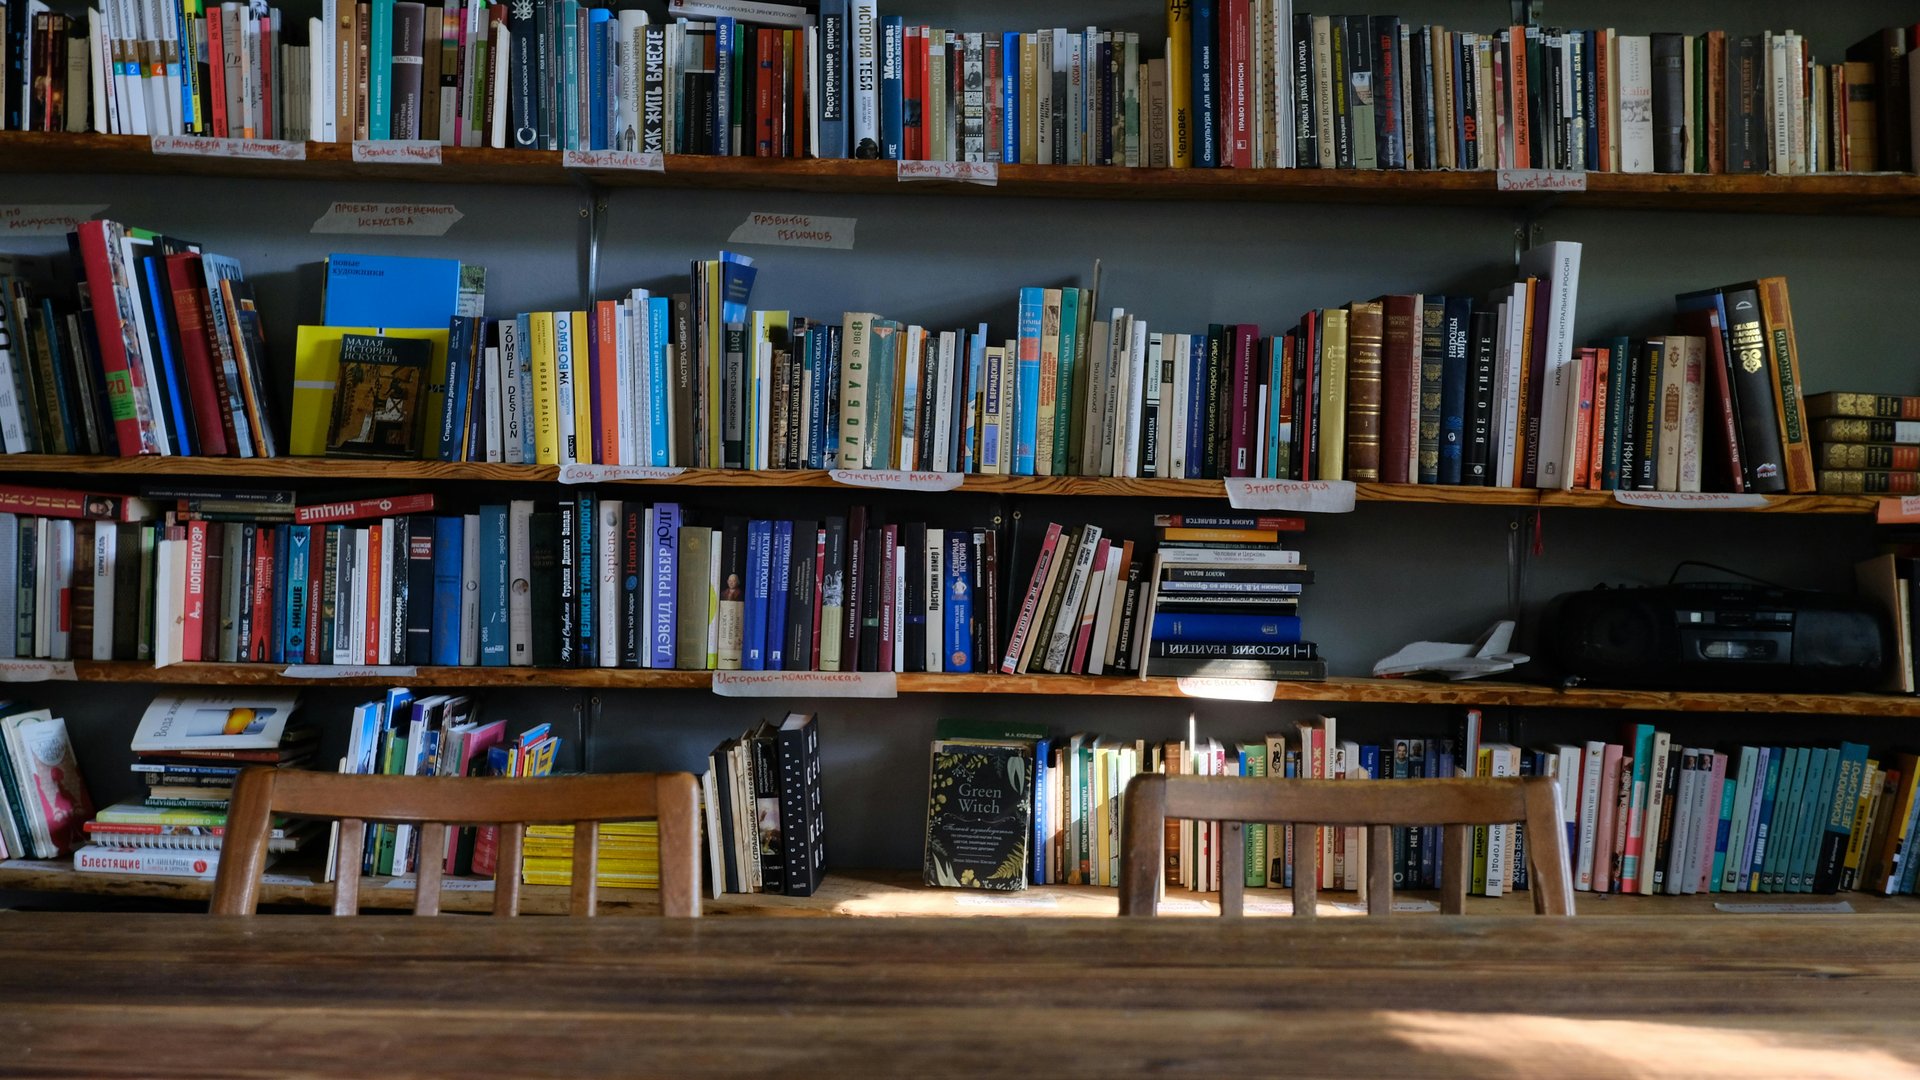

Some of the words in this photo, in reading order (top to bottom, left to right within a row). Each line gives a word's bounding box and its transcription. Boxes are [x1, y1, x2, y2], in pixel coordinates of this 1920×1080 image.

[826, 18, 834, 49] списки
[859, 6, 871, 58] ИСТОРИЯ
[646, 31, 664, 81] ВМЕСТЕ
[884, 25, 894, 79] Москва:
[1202, 46, 1210, 69] семьи
[1298, 40, 1307, 72] НАРОДА
[1516, 54, 1524, 78] НКВД
[825, 53, 834, 118] Расстрельные
[860, 61, 872, 91] ТЕБЯ
[1202, 73, 1210, 91] всей
[1300, 74, 1308, 101] ДРАМА
[645, 87, 662, 124] ЖИТЬ
[1152, 95, 1163, 139] ЭРЕНБУРГ
[1203, 94, 1211, 108] для
[1517, 88, 1525, 126] ДРАЛИСЬ
[1177, 108, 1186, 158] Человек
[1203, 111, 1211, 161] Физкультура
[1301, 103, 1310, 138] СУРОВАЯ
[357, 145, 398, 159] Gender
[645, 128, 662, 153] КАК
[1152, 143, 1163, 163] ИЛЬЯ
[900, 162, 941, 176] Memory
[1502, 173, 1540, 190] Soviet
[1541, 175, 1583, 189] studies
[335, 205, 378, 213] ПРОЕКТЫ
[385, 206, 454, 215] СОВРЕМЕННОГО
[358, 217, 414, 227] ИСКУССТВА
[754, 215, 810, 226] РАЗВИТИЕ
[777, 230, 833, 241] РЕГИОНОВ
[1559, 287, 1568, 339] ЦЕНТРАЛЬНАЯ
[347, 337, 383, 347] МАЛАЯ
[557, 320, 568, 352] БЛАГО
[679, 317, 687, 349] СИБИРИ
[730, 331, 740, 351] 2011
[1447, 317, 1458, 358] народы
[1456, 330, 1467, 358] мира
[345, 346, 393, 355] ИСТОРИЯ
[505, 325, 515, 378] ZOMBIE
[558, 355, 568, 369] ВО
[927, 346, 935, 372] ГЛАЗАМИ
[1211, 339, 1219, 365] МУЗЫКИ
[1479, 336, 1491, 391] ТИБЕТЕ
[1555, 341, 1564, 386] НАЛИЧНИКИ.
[1775, 330, 1792, 383] АНТОЛОГИЯ
[39, 349, 57, 412] ШРИФТЫ
[447, 361, 457, 397] динамика
[558, 370, 569, 385] УМ
[925, 373, 933, 399] СВОИМИ
[990, 358, 999, 398] ВЕРНАДСКИЙ
[1210, 366, 1218, 400] НАРОДНОЙ
[1411, 355, 1420, 413] КАЗАНСКИХ
[728, 361, 738, 430] Крестьяноведение
[810, 455, 817, 464] ОТ
[815, 332, 823, 359] ОКЕАНА
[989, 399, 997, 412] В.И.
[1091, 384, 1099, 413] ДОРОГАМИ
[1783, 384, 1800, 439] СКАЗОЧНАЯ
[443, 398, 455, 441] Спиральная
[508, 386, 517, 438] DESIGN
[540, 398, 549, 434] ВЛАСТЬ
[1147, 417, 1156, 461] ШАМАНИЗМ
[1208, 433, 1216, 454] АРХИВА
[1410, 418, 1418, 458] КОСТЮМ
[1476, 418, 1486, 443] ВСЕ
[1527, 417, 1538, 473] НГАНАСАНЫ
[604, 468, 677, 481] практики
[910, 472, 943, 481] МИРА
[1245, 483, 1330, 495] ЭТНОГРАФИЯ
[562, 510, 571, 535] Запада
[581, 499, 592, 553] ПРОШЛОГО
[627, 512, 637, 538] Deus
[657, 507, 673, 548] ДОЛГ
[562, 539, 571, 565] Дикого
[626, 540, 637, 574] Homo
[761, 533, 770, 567] ИСТОРИЯ
[930, 551, 938, 571] номер
[952, 538, 960, 576] ВСЕМИРНАЯ
[959, 542, 967, 572] ИСТОРИЯ
[256, 556, 265, 604] Imperialism
[265, 557, 273, 588] Culture
[562, 568, 571, 597] Стрелки
[580, 554, 591, 591] ТАЙНЫ
[658, 548, 672, 597] ГРЕБЕР
[760, 568, 768, 598] РОССИИ
[929, 573, 939, 611] Преступник
[581, 592, 592, 637] ВЕЛИКИЕ
[658, 601, 673, 655] ДЭВИД
[1120, 618, 1131, 651] ЕКАТЕРИНА
[1126, 588, 1134, 615] МЕДИЧИ
[1169, 644, 1226, 655] РЕЛИГИЙ
[1232, 646, 1289, 655] ИСТОРИЯ
[717, 673, 862, 688] Историко-политическая
[746, 761, 754, 806] ЦВЕТОВОДА
[959, 784, 1002, 798] Green
[1830, 760, 1851, 826] ПСИХОЛОГИЯ
[1842, 760, 1861, 828] ДЕТЕЙ-СИРОТ
[1860, 763, 1874, 799] Identity
[784, 741, 797, 875] ИНСЕКТОПЕДИЯ
[959, 799, 1000, 814] Witch
[749, 809, 759, 860] СПРАВОЧНИК
[1255, 830, 1263, 871] ПОЛНЫЙ
[1475, 828, 1483, 858] СОЙТИ!
[1491, 844, 1500, 873] ГОРОДЕ
